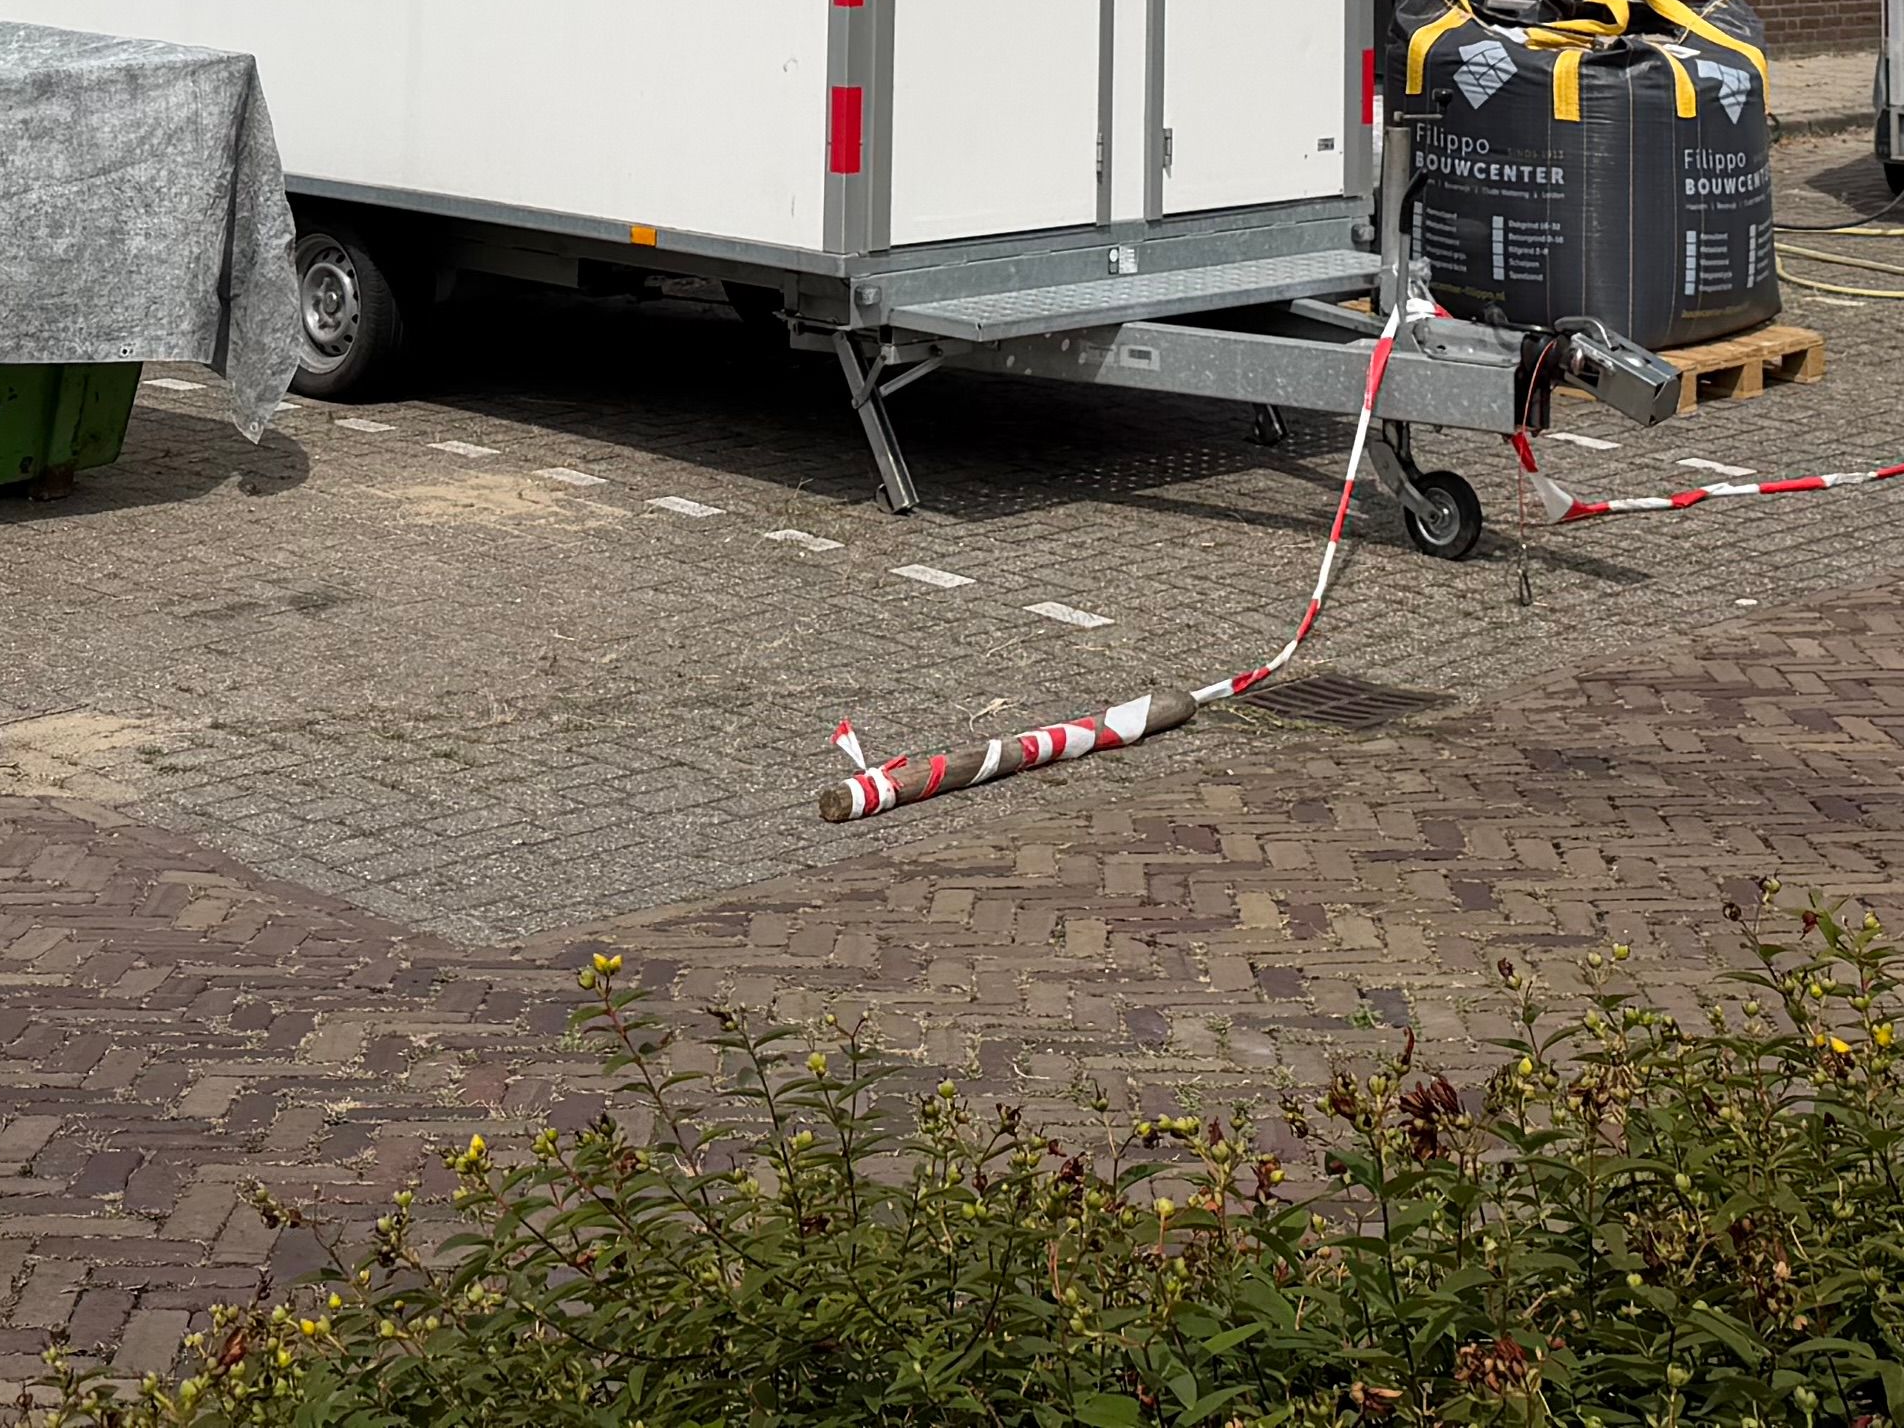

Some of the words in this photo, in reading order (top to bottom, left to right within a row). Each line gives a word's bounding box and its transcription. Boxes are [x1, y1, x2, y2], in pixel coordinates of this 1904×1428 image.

[1416, 123, 1490, 156] Filippo
[1415, 151, 1565, 185] BOUWCENTER
[1684, 149, 1746, 174] Filippo
